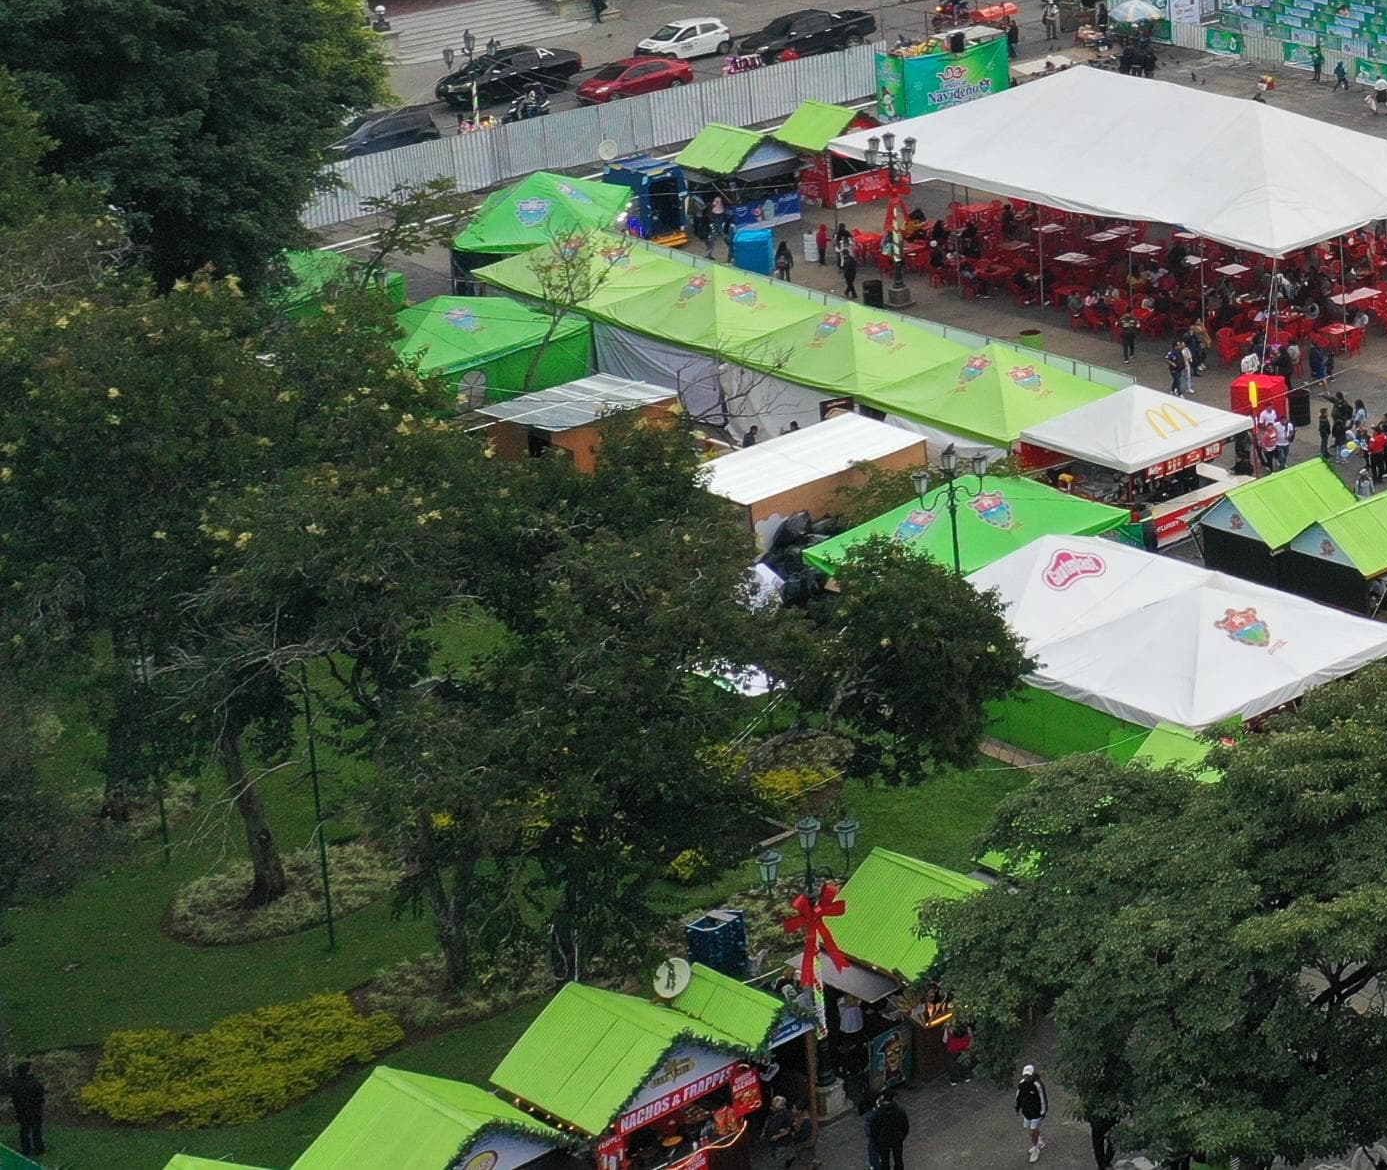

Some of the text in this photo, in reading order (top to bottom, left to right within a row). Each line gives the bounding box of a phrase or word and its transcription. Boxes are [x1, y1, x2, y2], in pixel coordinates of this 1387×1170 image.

[927, 85, 980, 105] Navideño
[620, 1099, 670, 1132] NACHOS
[671, 1097, 682, 1108] &
[683, 1065, 734, 1101] FRAPPES
